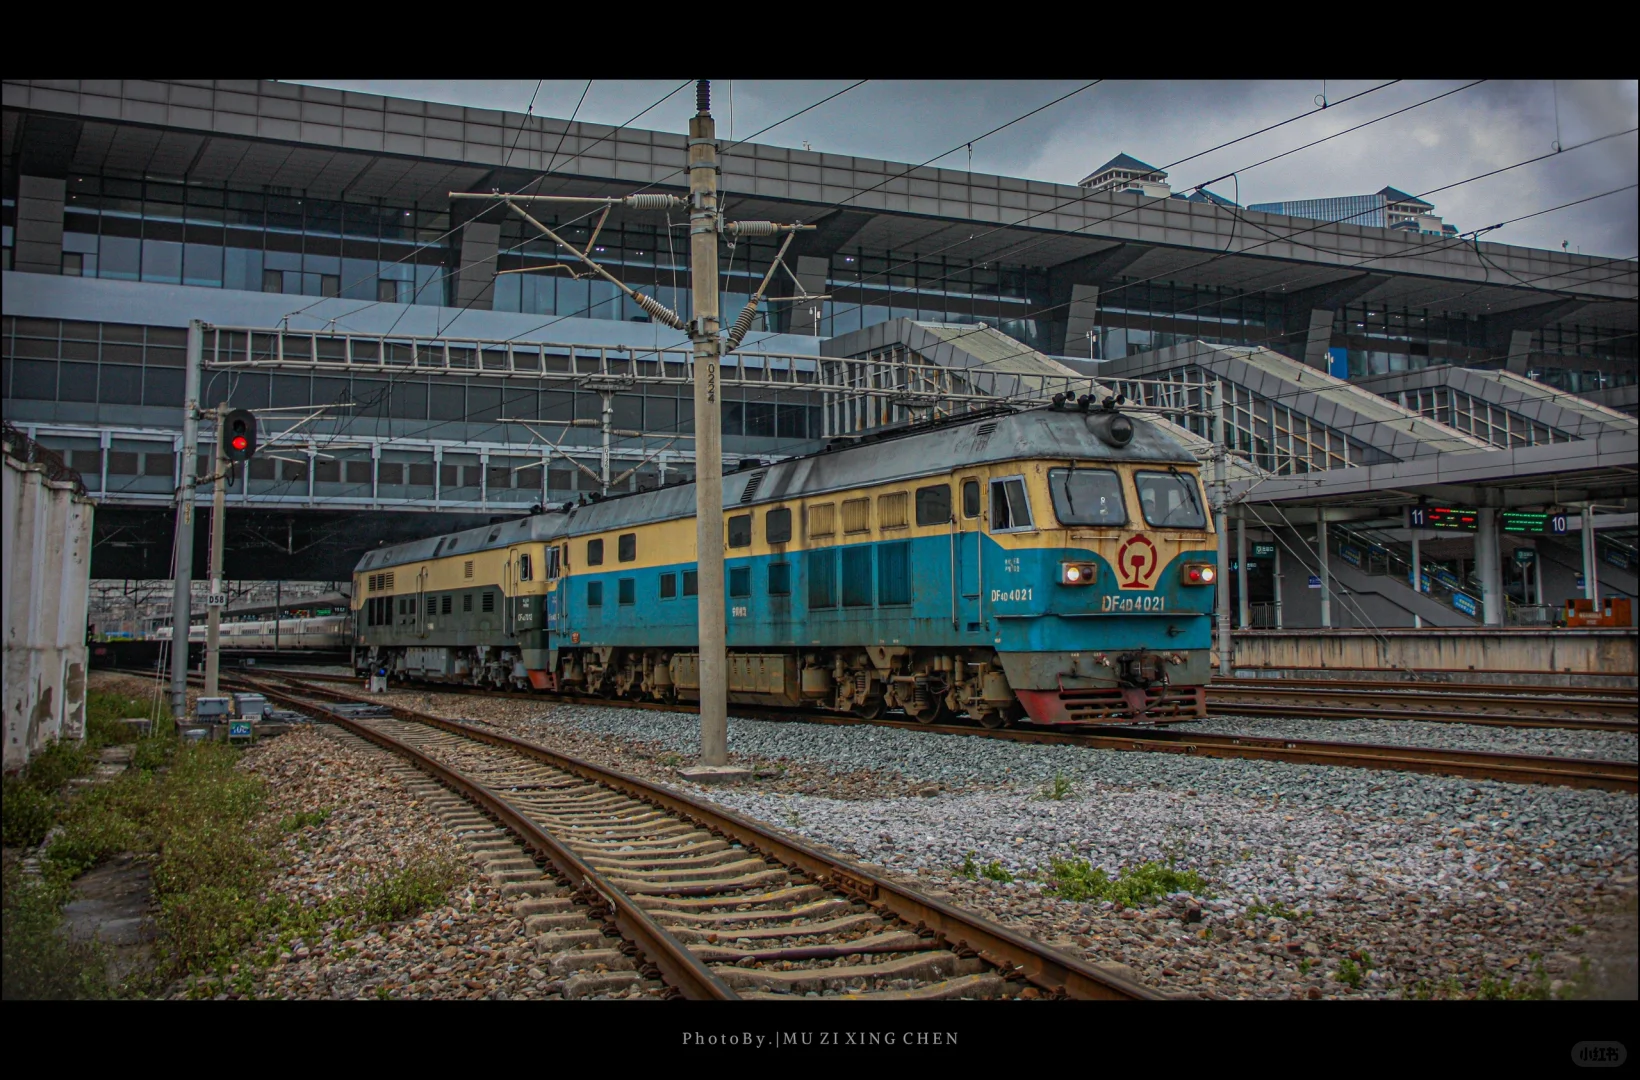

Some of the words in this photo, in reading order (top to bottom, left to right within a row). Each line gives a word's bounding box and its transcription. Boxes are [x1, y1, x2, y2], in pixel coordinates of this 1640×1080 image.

[707, 363, 715, 404] 0224
[1411, 509, 1424, 525] 11
[1551, 516, 1566, 532] 10
[209, 595, 224, 604] D58
